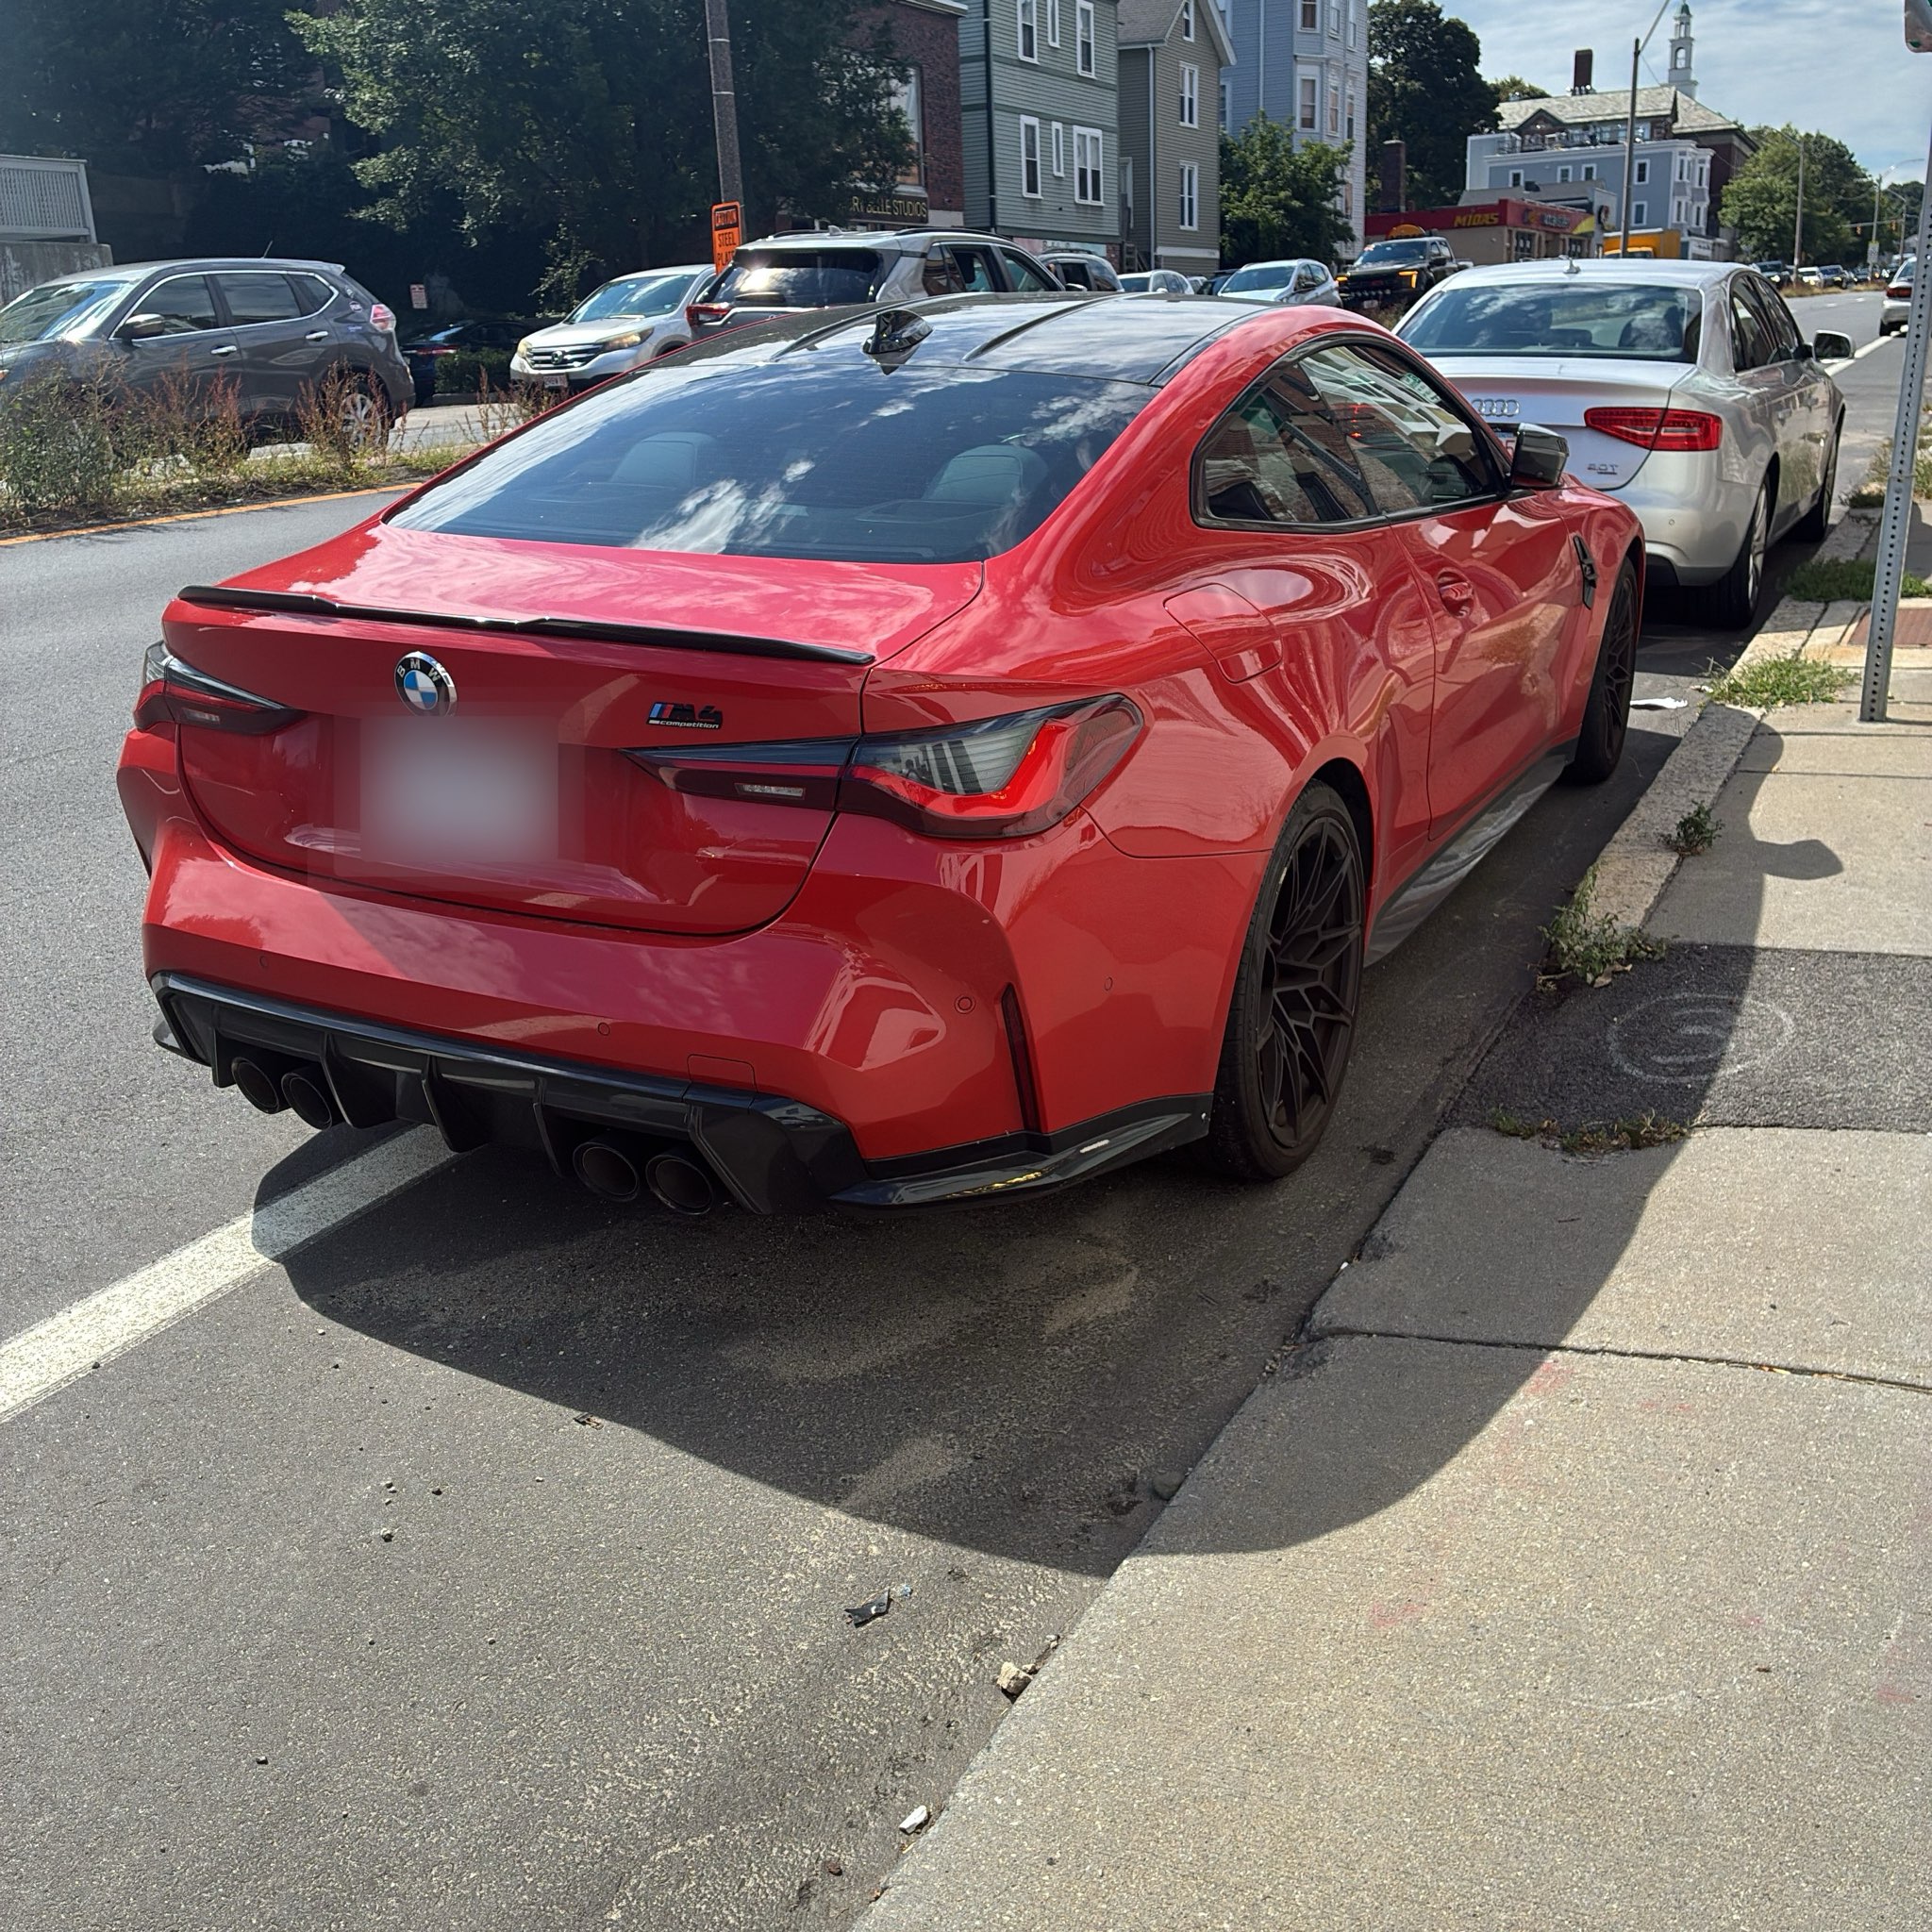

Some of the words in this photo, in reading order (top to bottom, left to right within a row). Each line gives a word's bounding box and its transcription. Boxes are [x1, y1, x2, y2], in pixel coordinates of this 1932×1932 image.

[892, 199, 926, 217] STUDIOS
[1454, 212, 1499, 227] MIDAS
[718, 232, 737, 246] STEEL
[396, 658, 441, 682] BMW
[659, 720, 719, 729] competition
